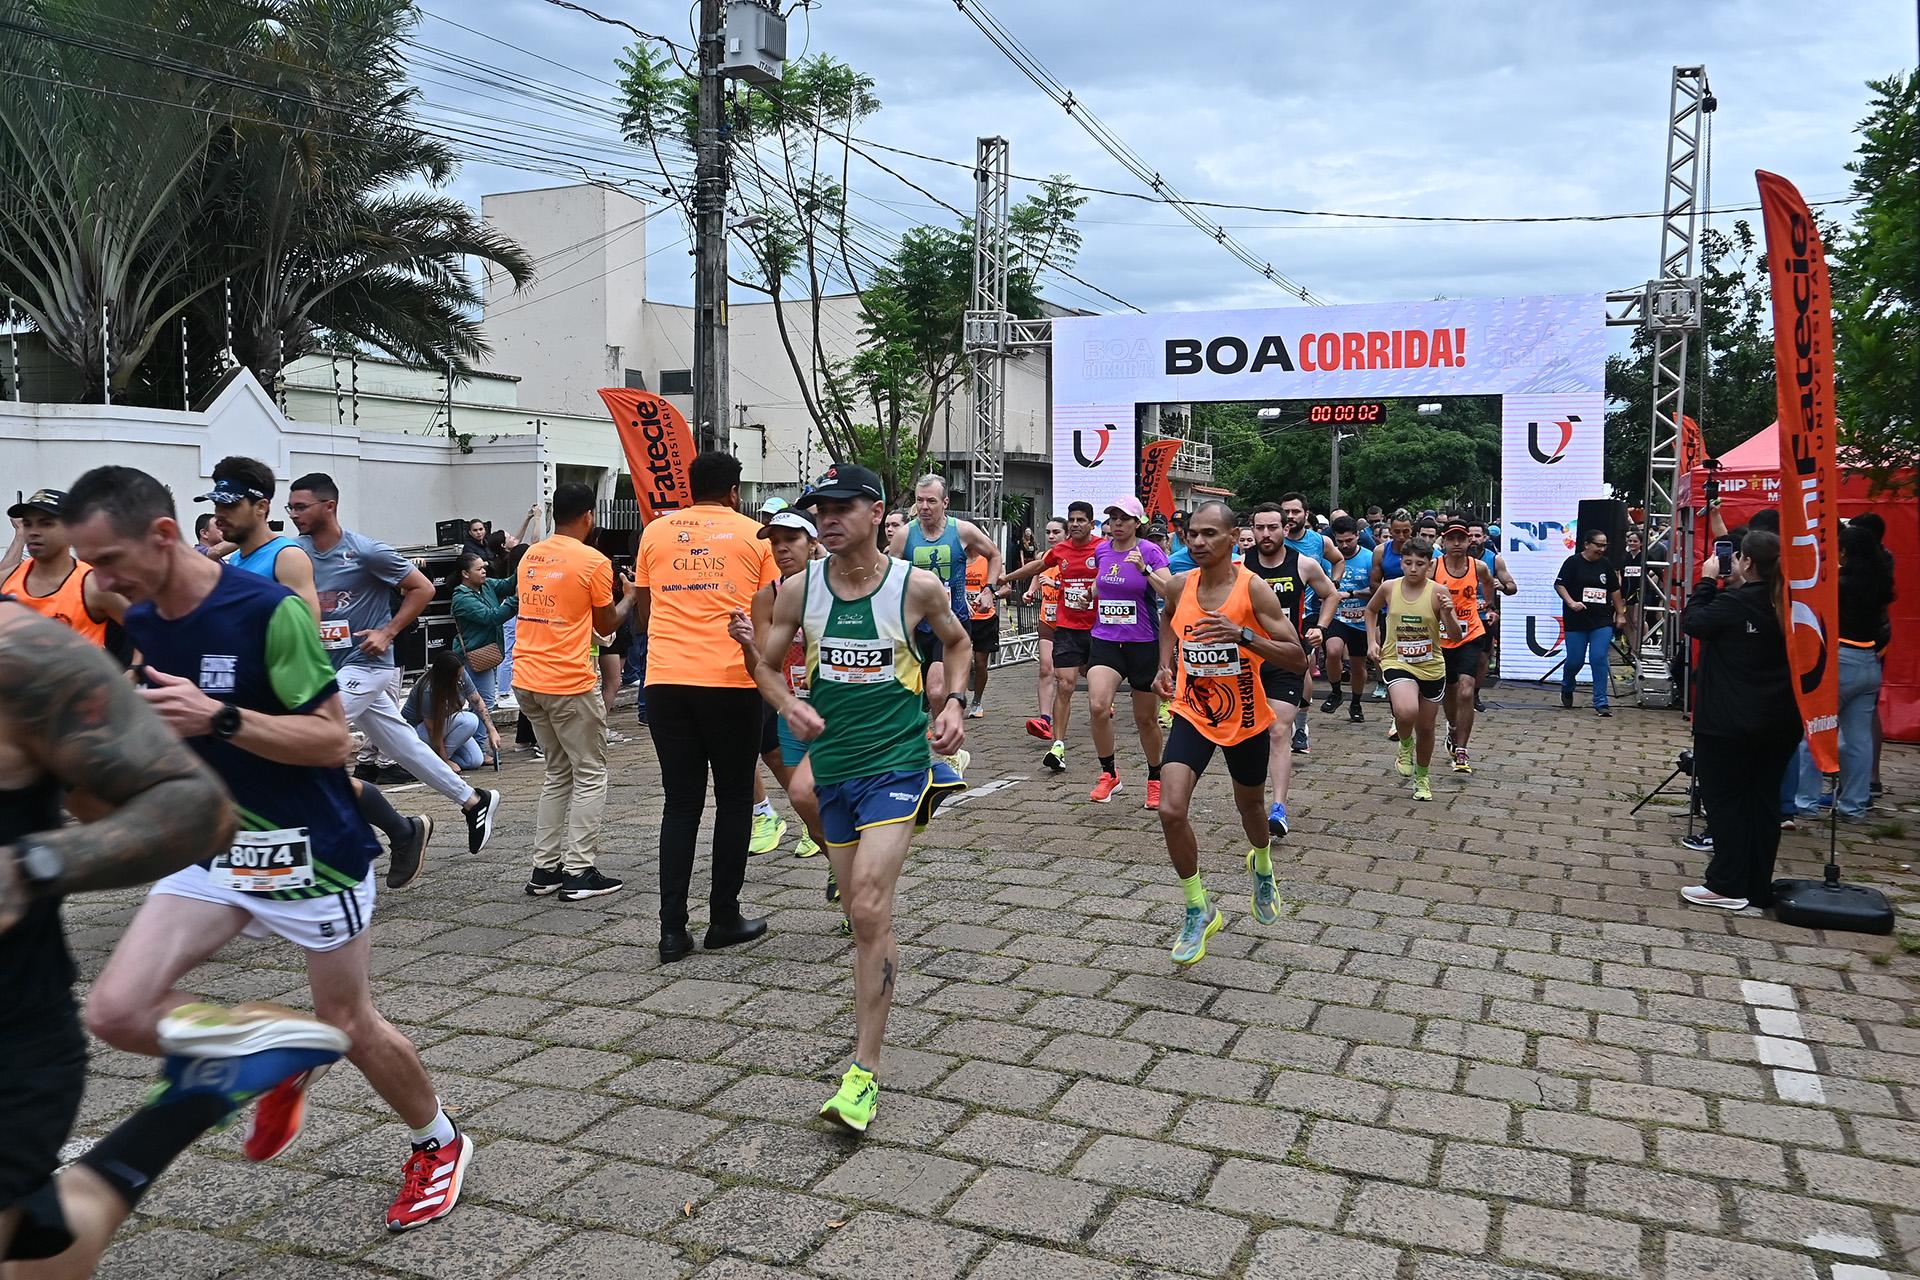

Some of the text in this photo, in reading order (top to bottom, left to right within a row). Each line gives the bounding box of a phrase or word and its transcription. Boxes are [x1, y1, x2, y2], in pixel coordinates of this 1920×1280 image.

[1165, 336, 1295, 375] BOA
[1299, 328, 1466, 372] CORRIDA!
[672, 557, 726, 571] GLEVIS
[1104, 606, 1130, 615] 8003
[1188, 650, 1229, 663] 8004
[1402, 645, 1427, 655] 5070
[831, 649, 882, 667] 8052
[229, 844, 294, 868] 8074
